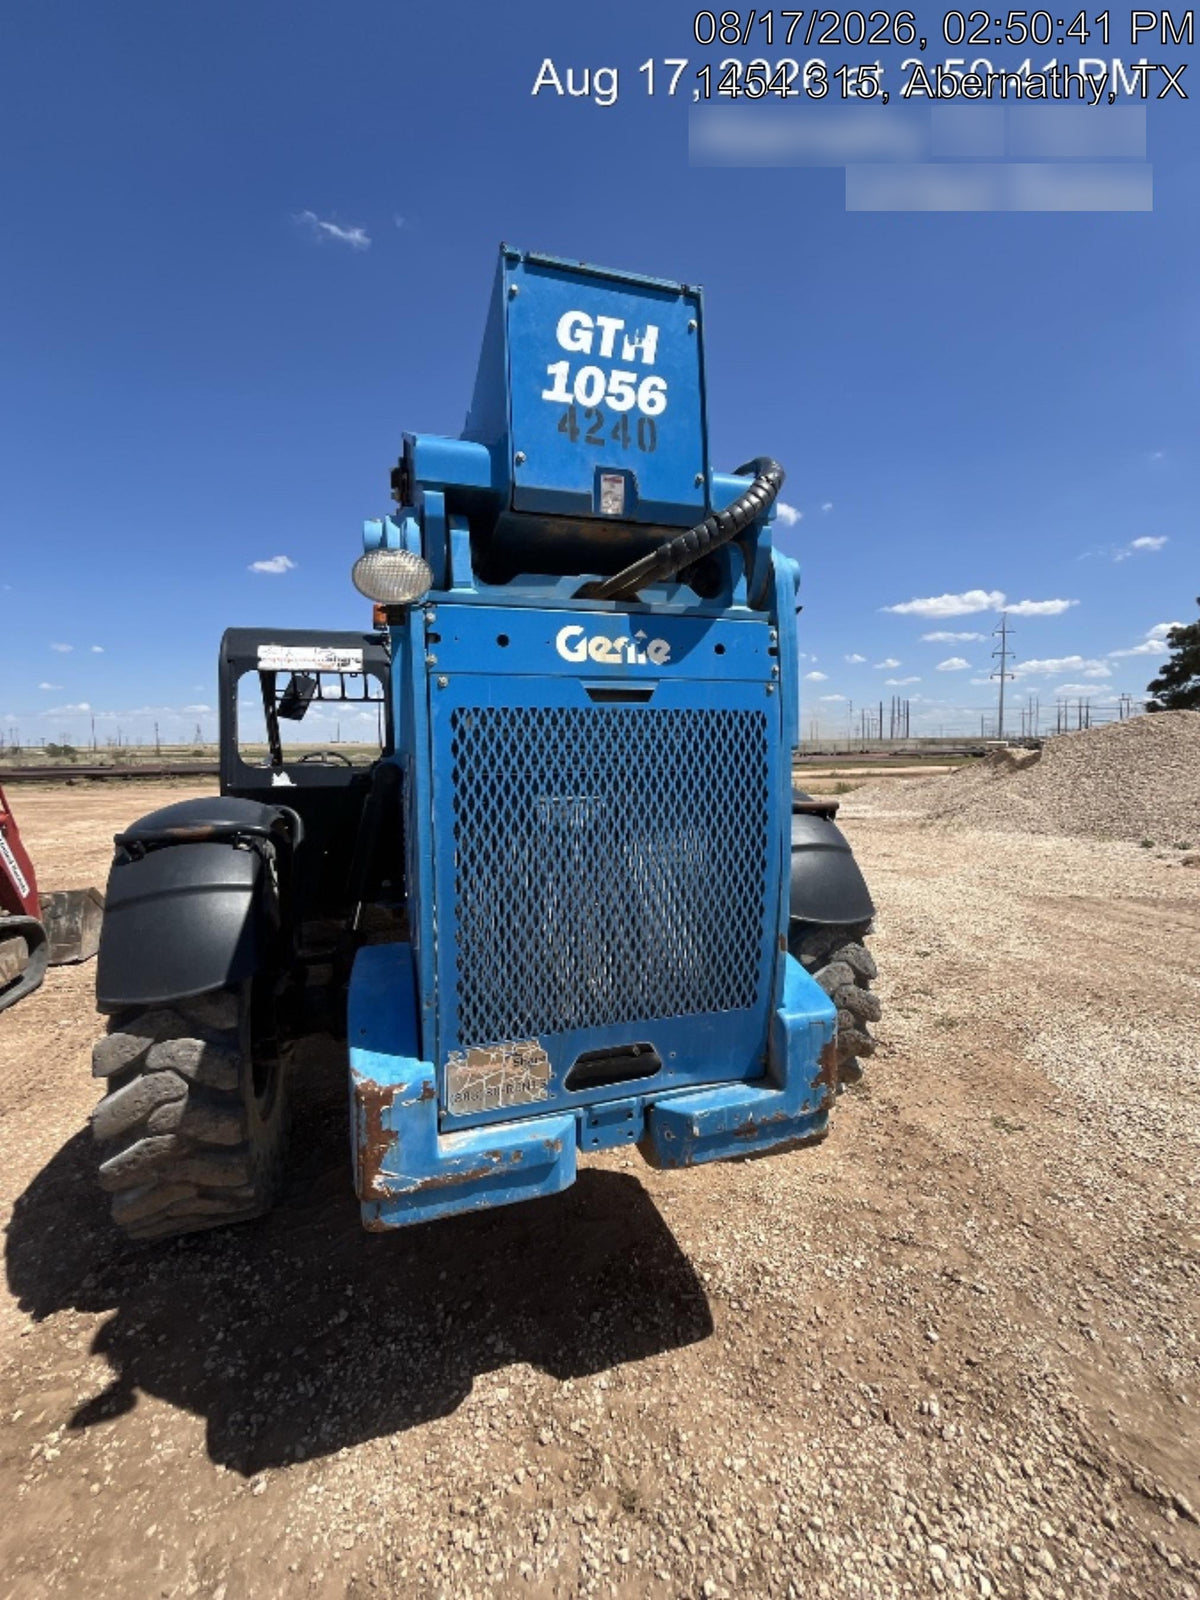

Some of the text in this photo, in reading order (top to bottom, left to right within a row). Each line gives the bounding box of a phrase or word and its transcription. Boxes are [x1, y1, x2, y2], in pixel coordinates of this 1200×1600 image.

[555, 310, 659, 365] GTH
[541, 360, 668, 416] 1056
[557, 404, 657, 453] 4240
